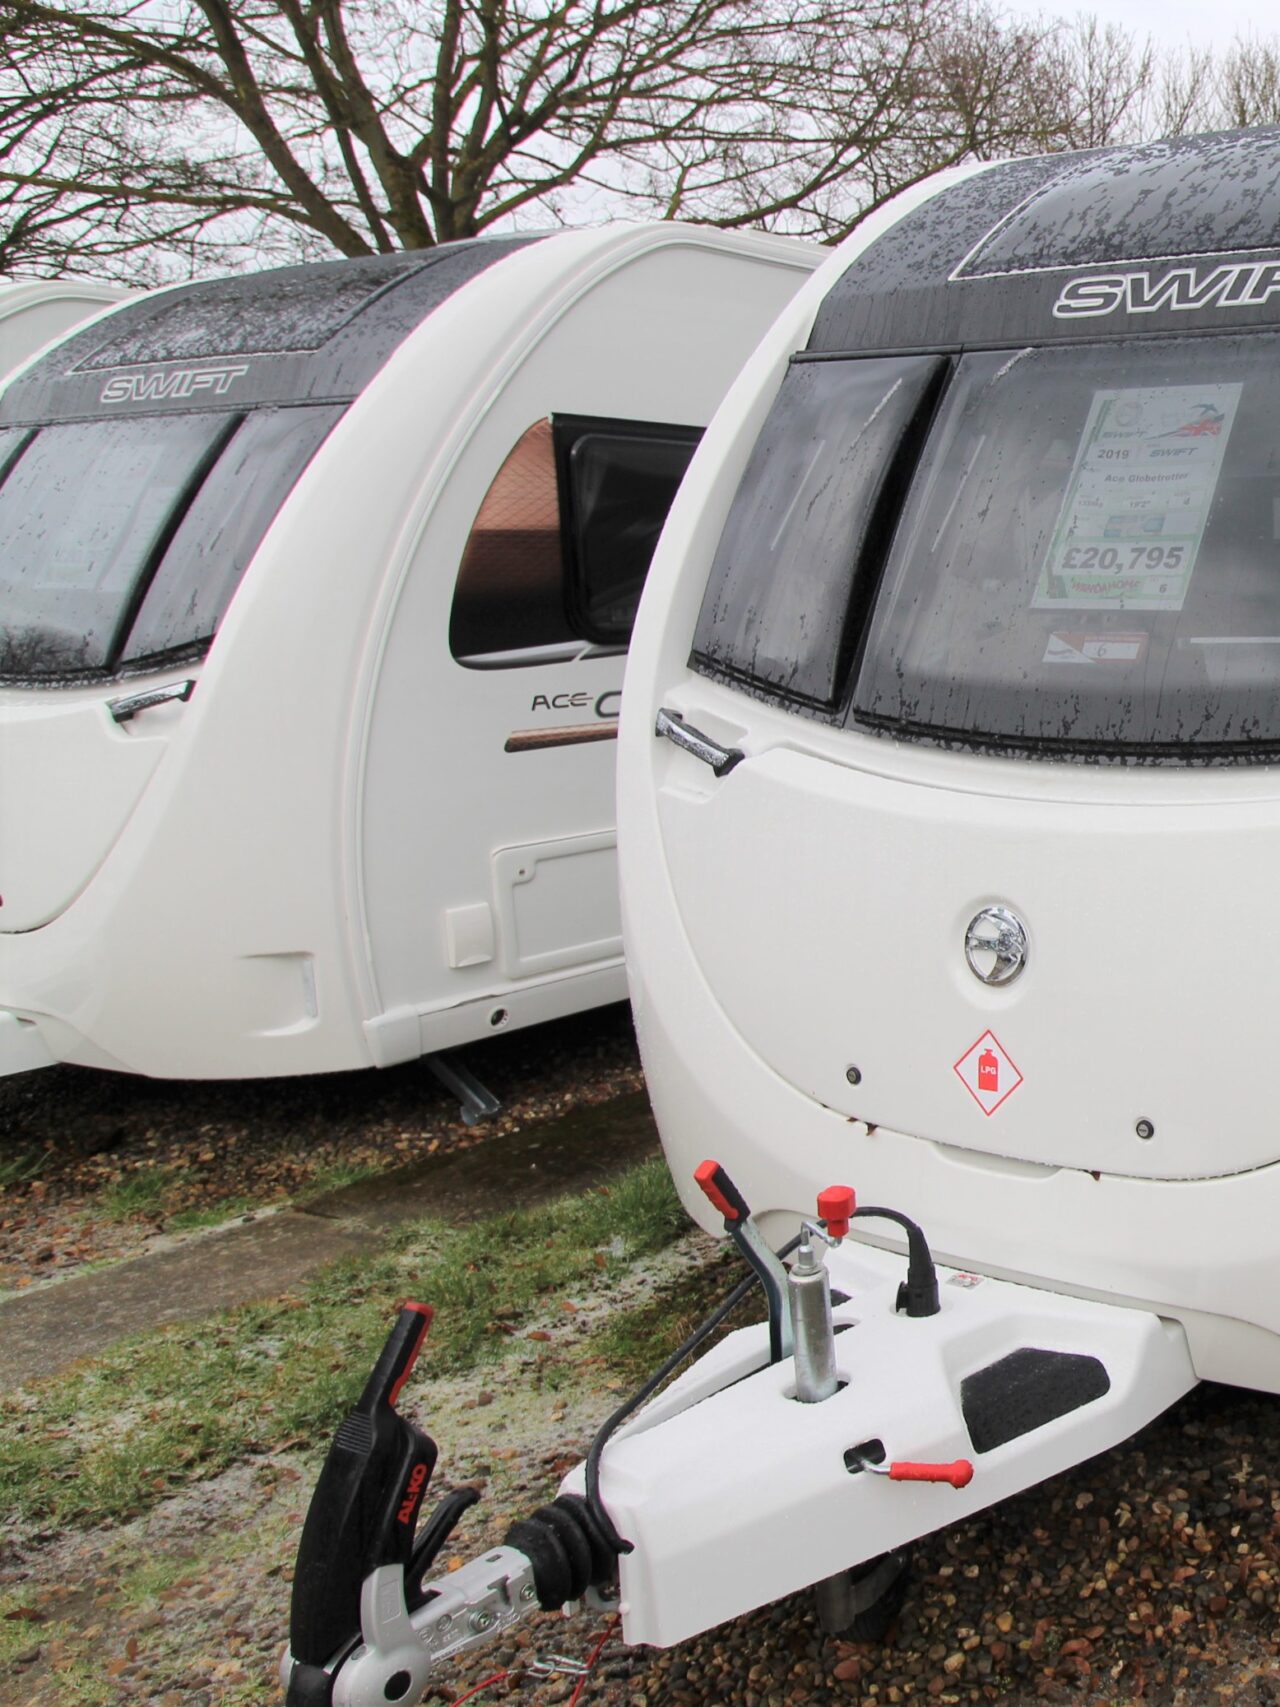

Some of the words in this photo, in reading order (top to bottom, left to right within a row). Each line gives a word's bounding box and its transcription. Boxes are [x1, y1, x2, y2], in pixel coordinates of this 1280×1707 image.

[101, 364, 249, 403] SWIFT
[1097, 449, 1130, 460] 2019
[1149, 447, 1199, 458] SWIFT
[1104, 474, 1126, 483] Ace
[1127, 471, 1190, 483] Globetrotter
[1062, 547, 1184, 574] £20,795
[1158, 584, 1168, 594] 6
[532, 692, 593, 711] ACE
[980, 1065, 997, 1075] LPG
[397, 1463, 428, 1525] AL-KO
